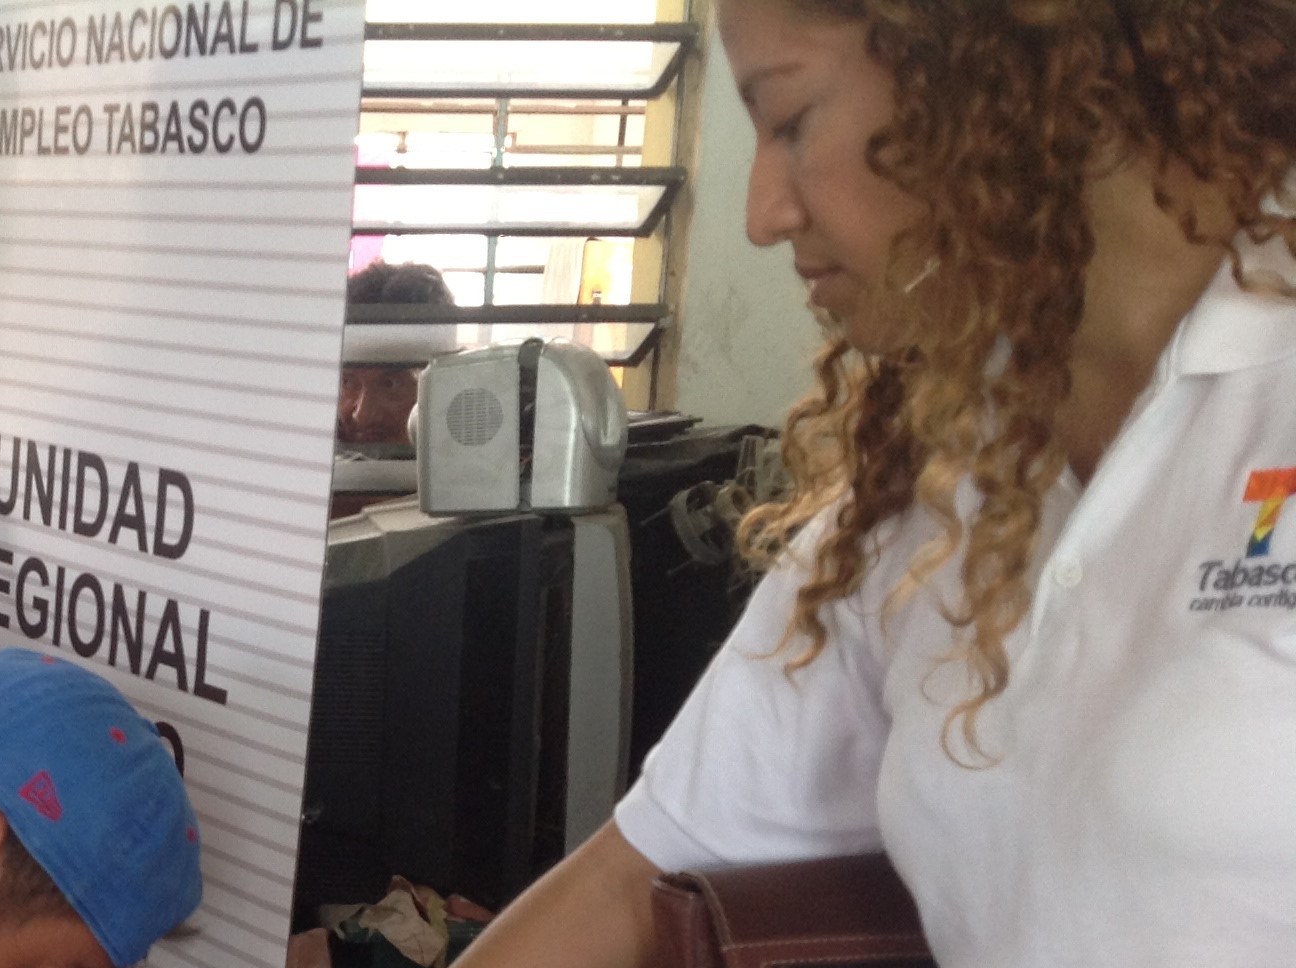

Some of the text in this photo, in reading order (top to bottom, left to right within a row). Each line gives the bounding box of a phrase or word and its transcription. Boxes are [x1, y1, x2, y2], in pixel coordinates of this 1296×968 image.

[86, 0, 259, 66] NACIONAL
[272, 0, 324, 52] DE
[104, 96, 267, 155] TABASCO
[1198, 558, 1296, 592] Tabasc
